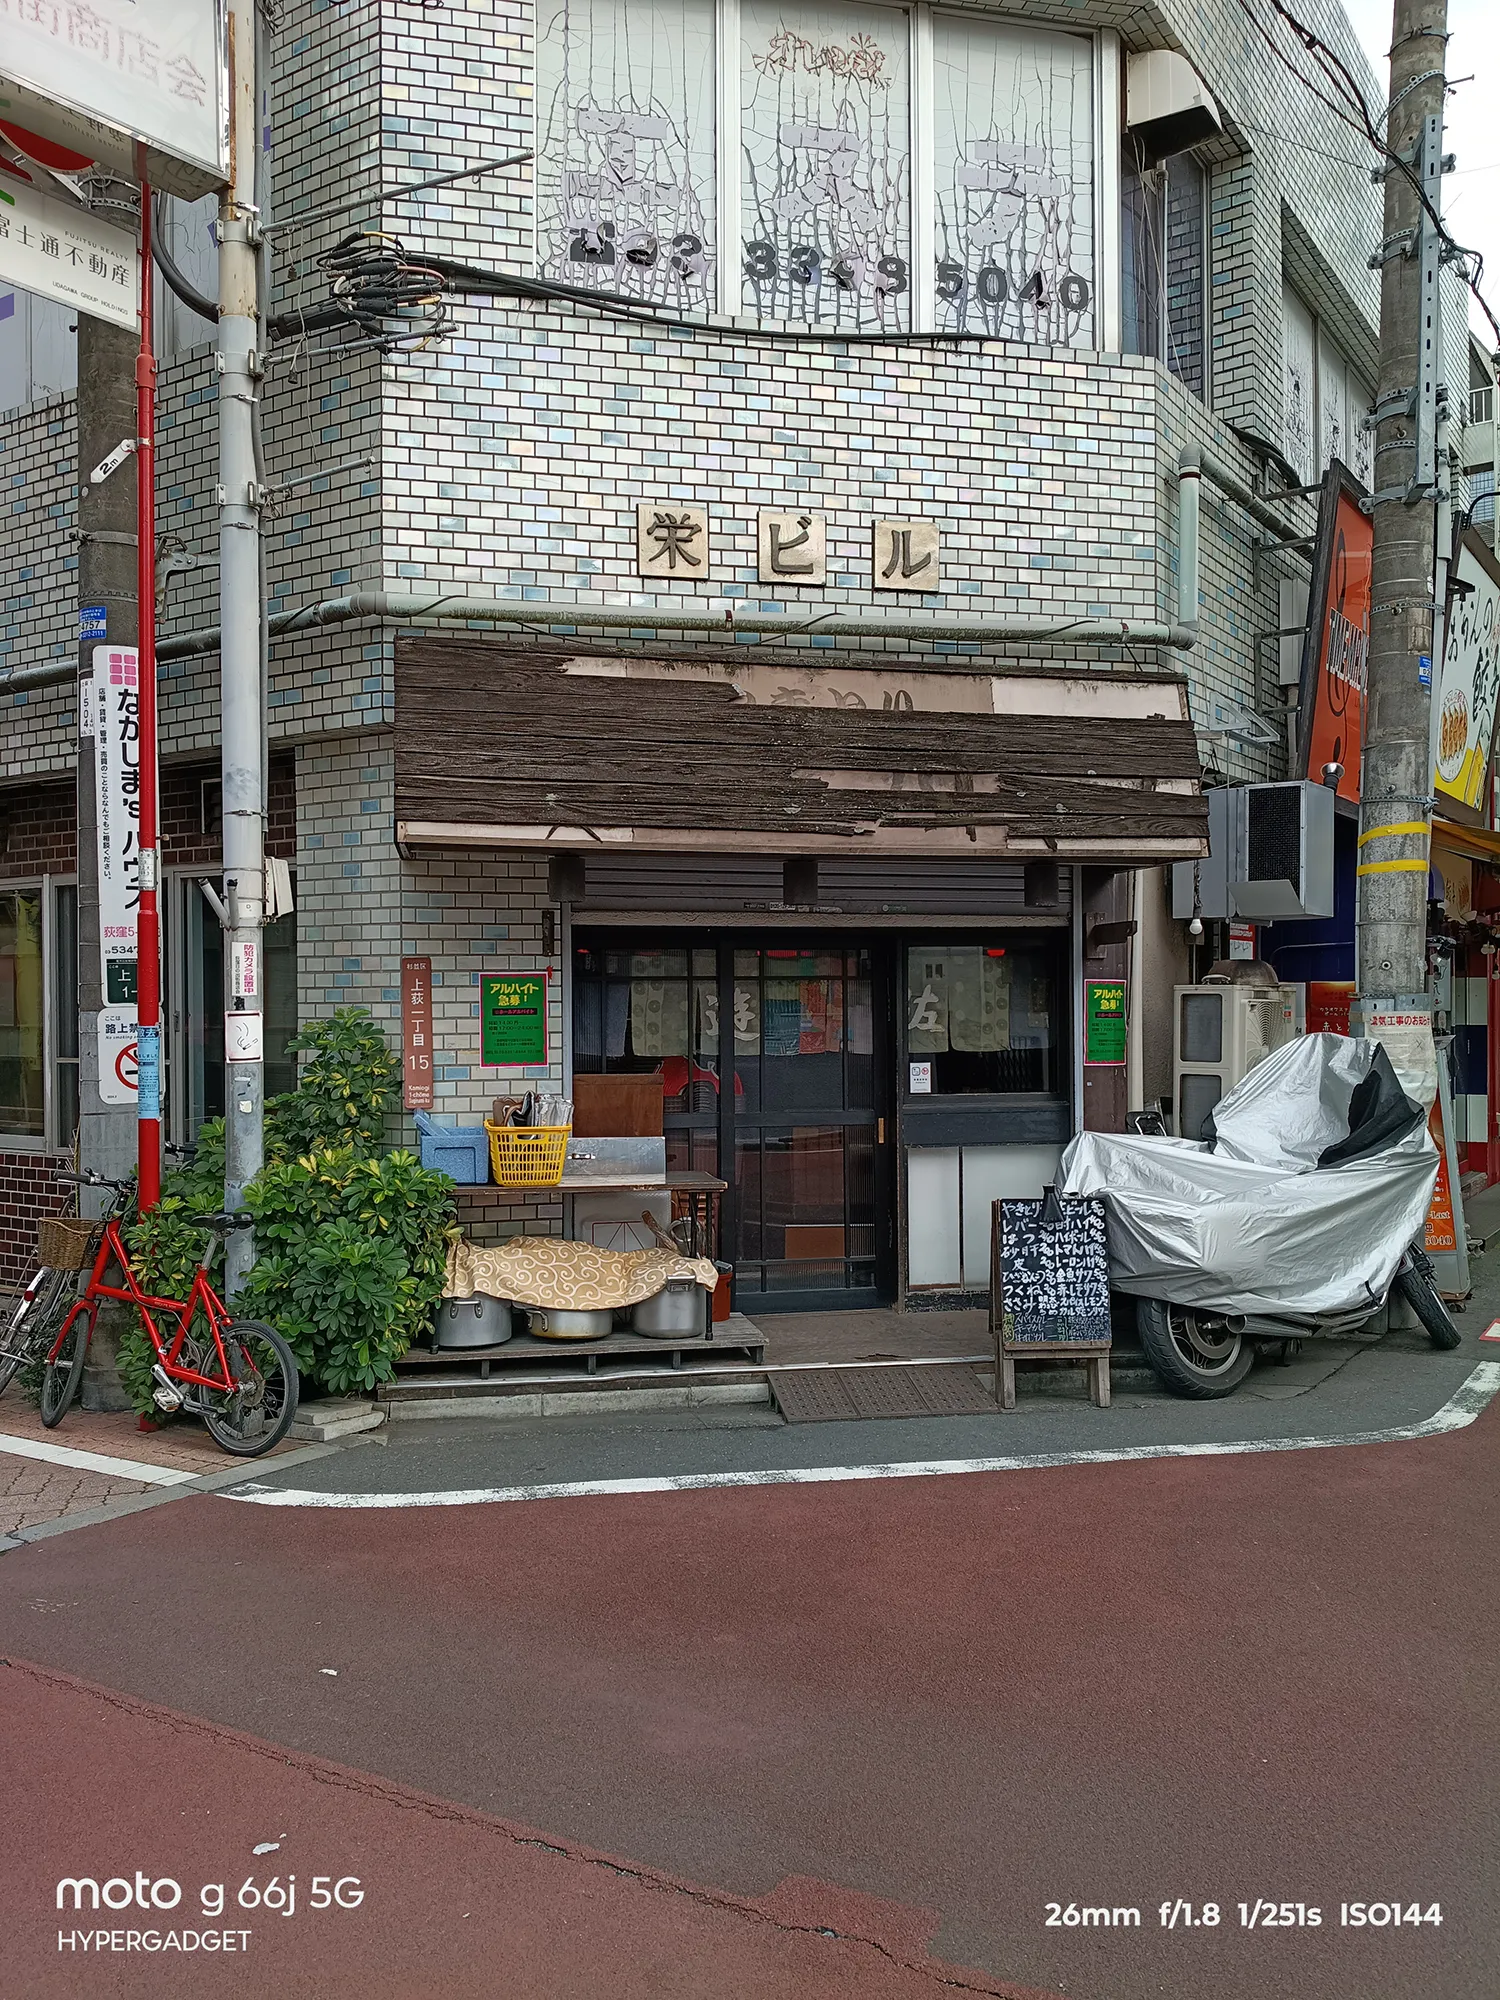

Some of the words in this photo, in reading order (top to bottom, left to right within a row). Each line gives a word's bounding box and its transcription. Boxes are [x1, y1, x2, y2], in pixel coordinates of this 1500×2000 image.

[64, 230, 98, 249] FUJITSU
[100, 245, 129, 263] REALTY
[647, 512, 931, 580] 栄ビル
[118, 969, 132, 982] 上
[243, 944, 254, 993] 防犯カメラ設置中
[411, 979, 425, 1047] 上荻一丁目
[105, 1022, 138, 1034] 路上禁
[409, 1055, 429, 1070] 15
[1002, 1217, 1037, 1233] レバー
[1002, 1233, 1035, 1245] はつ
[1003, 1284, 1043, 1297] つくね
[1003, 1297, 1037, 1317] ささみ
